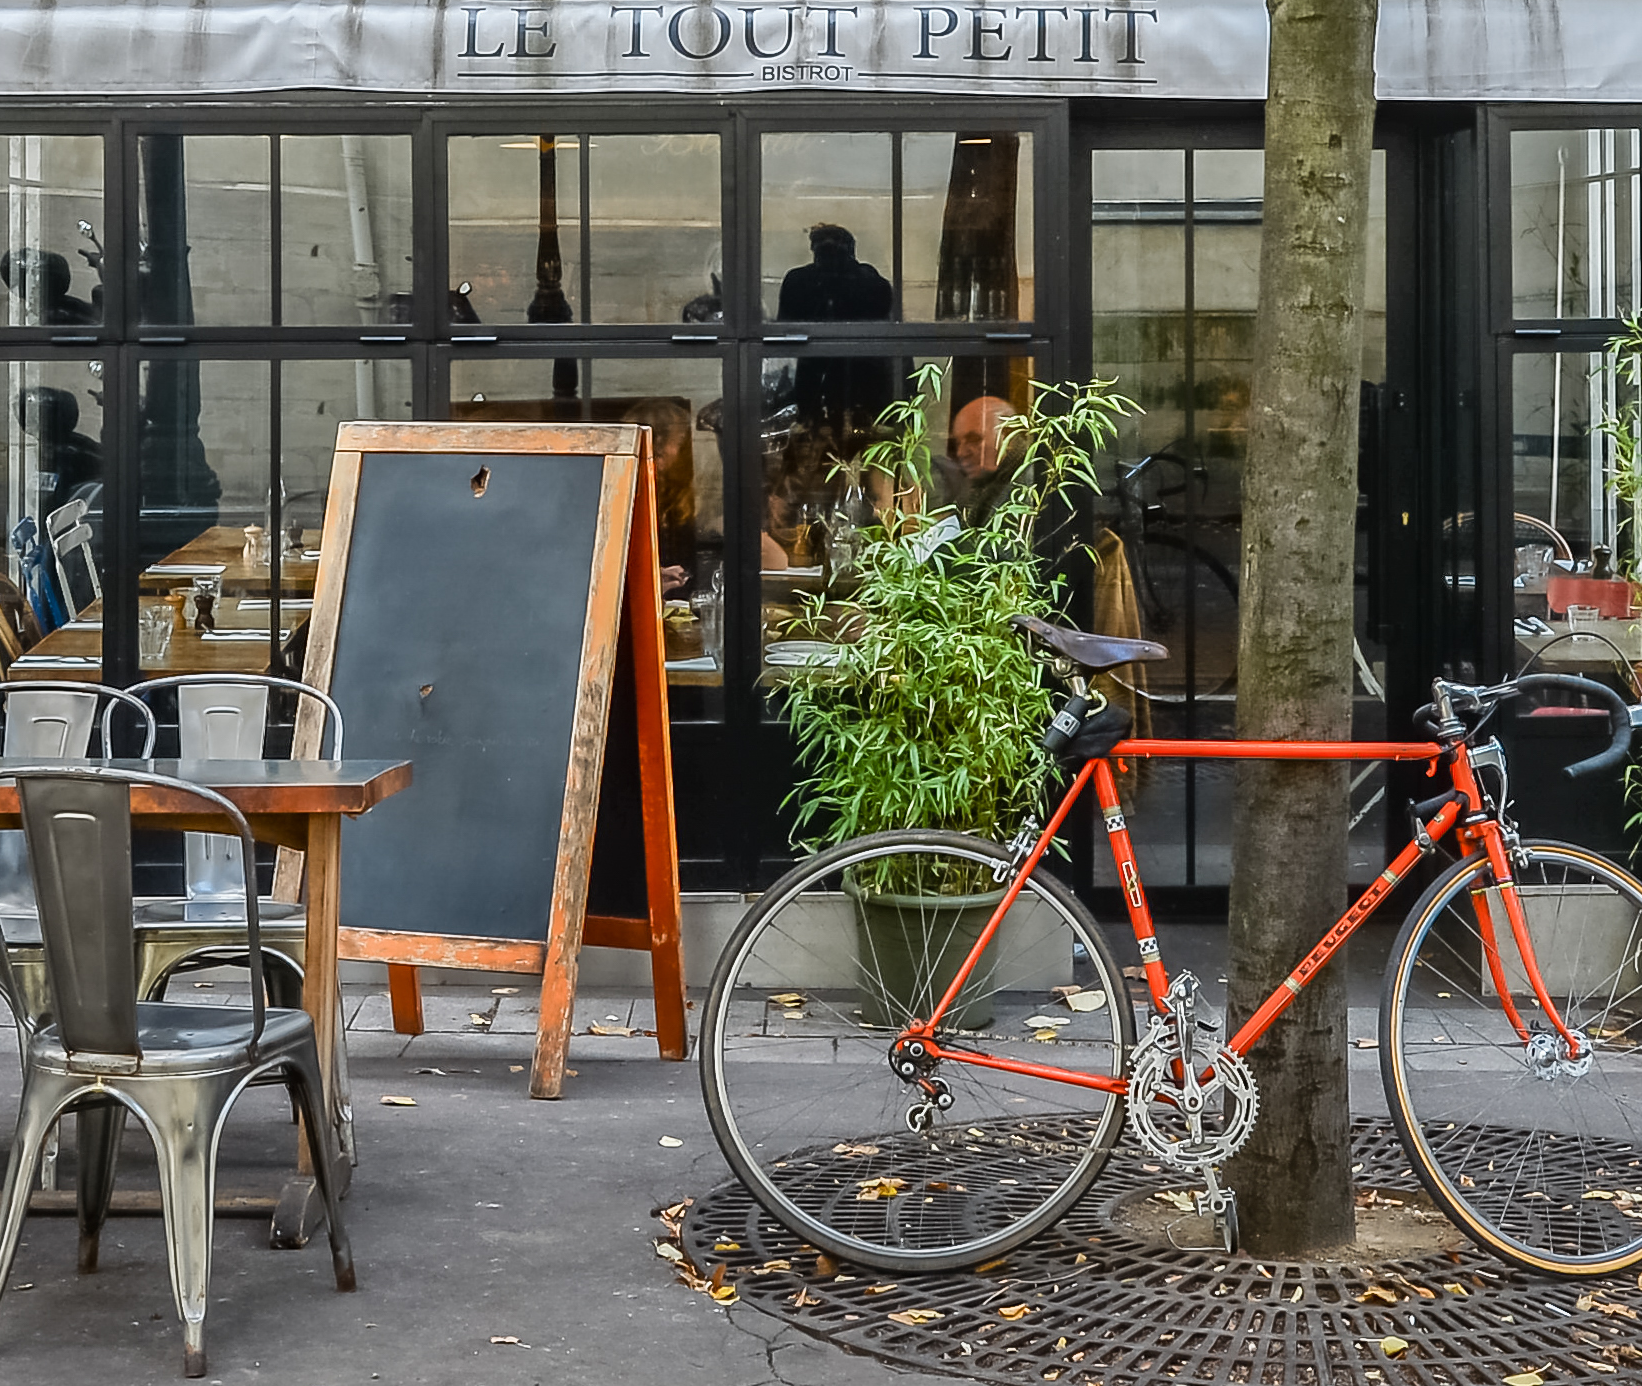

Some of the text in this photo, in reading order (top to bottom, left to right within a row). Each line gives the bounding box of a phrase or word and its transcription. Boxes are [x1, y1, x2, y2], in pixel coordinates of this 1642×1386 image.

[456, 5, 1159, 65] LE TOUT PETIT
[761, 64, 854, 82] BISTROT
[1298, 883, 1382, 977] PEUGEOT
